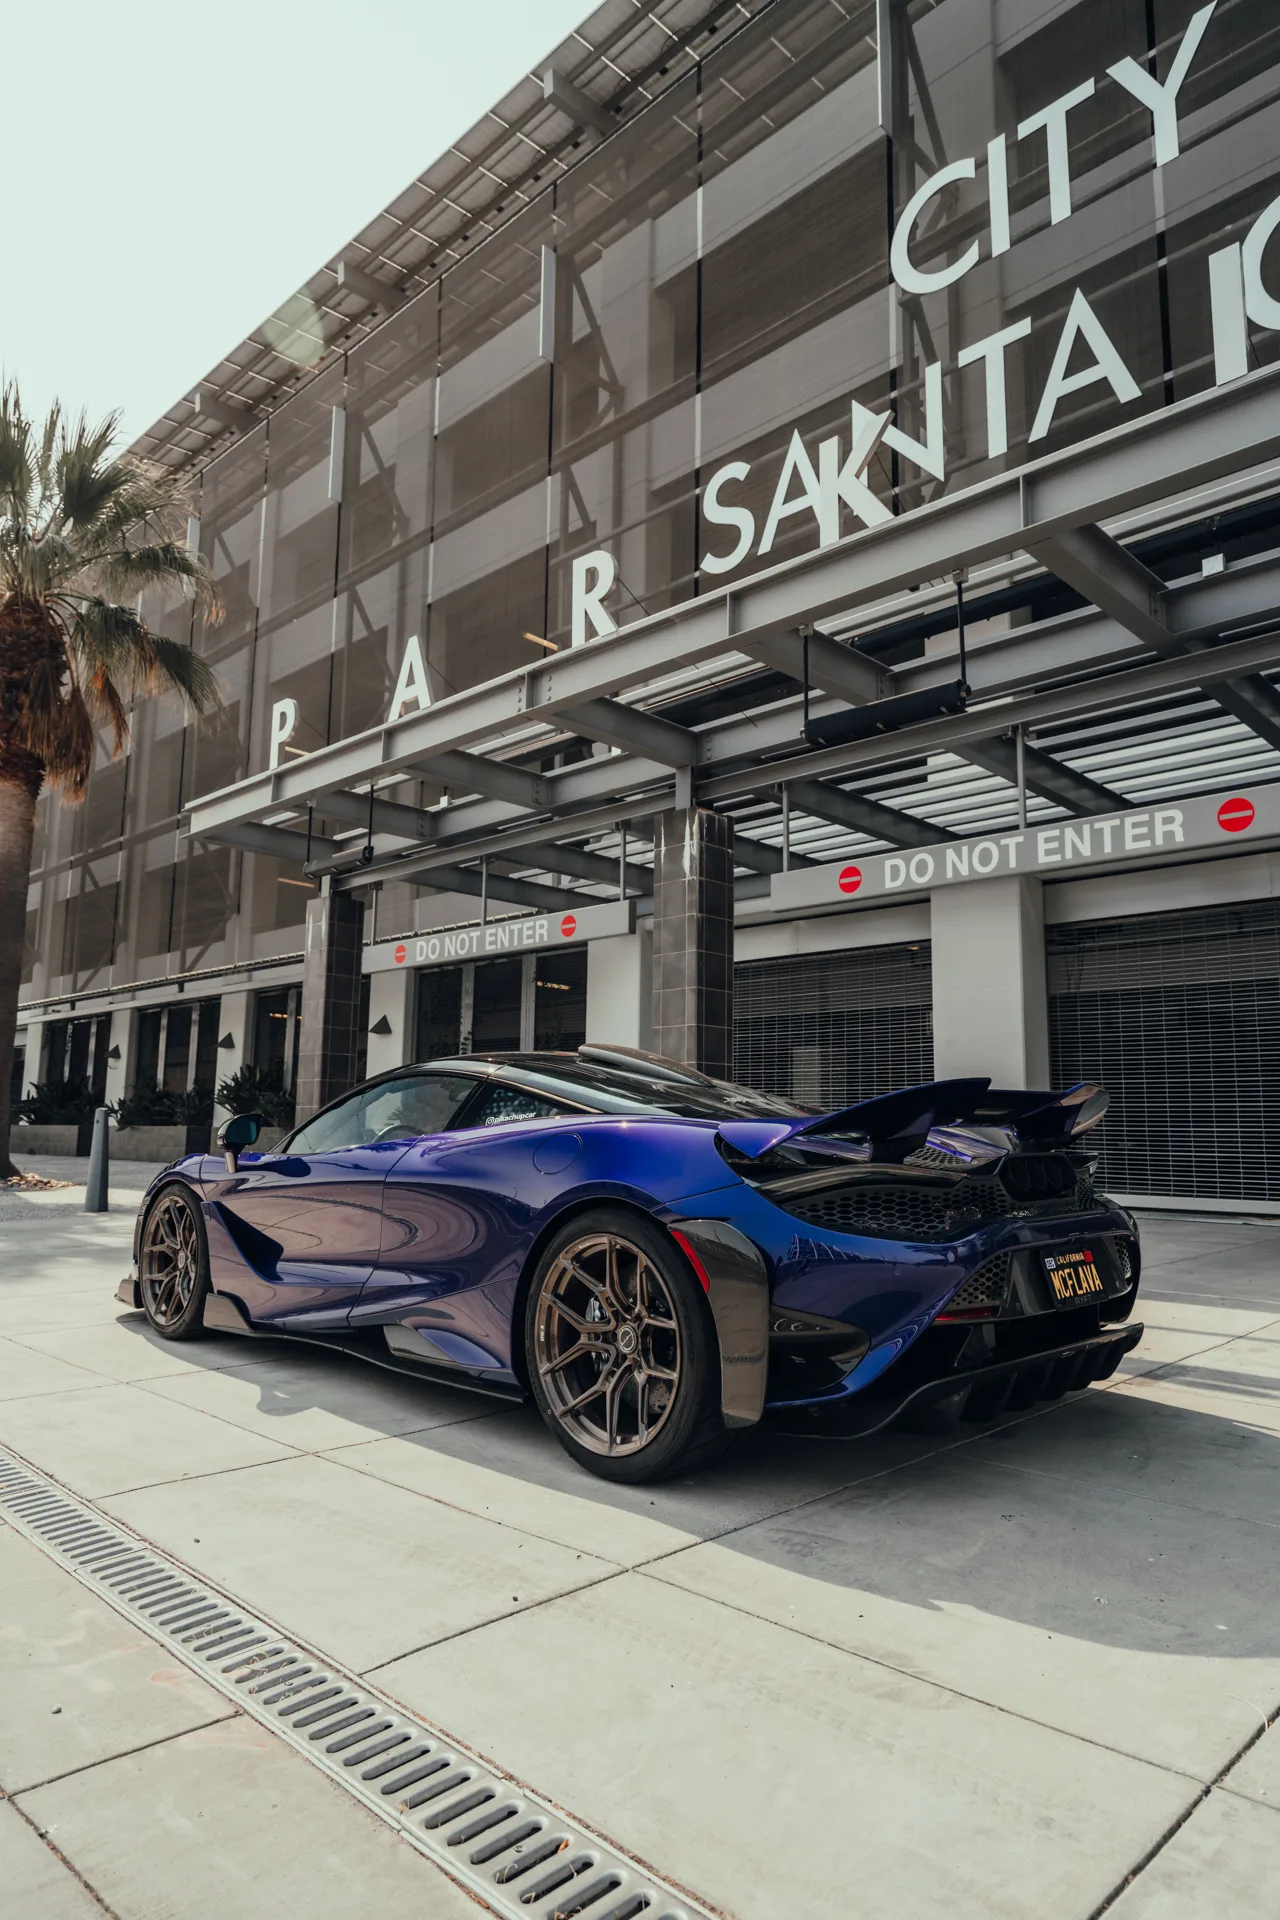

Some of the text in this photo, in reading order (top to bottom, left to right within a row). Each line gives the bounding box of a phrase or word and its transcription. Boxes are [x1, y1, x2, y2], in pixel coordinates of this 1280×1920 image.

[889, 0, 1218, 294] CITY
[700, 287, 1143, 575] SANTA
[884, 808, 1185, 889] DO NOT ENTER
[415, 919, 549, 962] DO NOT ENTER
[1056, 1252, 1085, 1265] CALIFORNIA
[1050, 1263, 1103, 1299] MCFLAVA
[1074, 1294, 1092, 1305] RYFT
